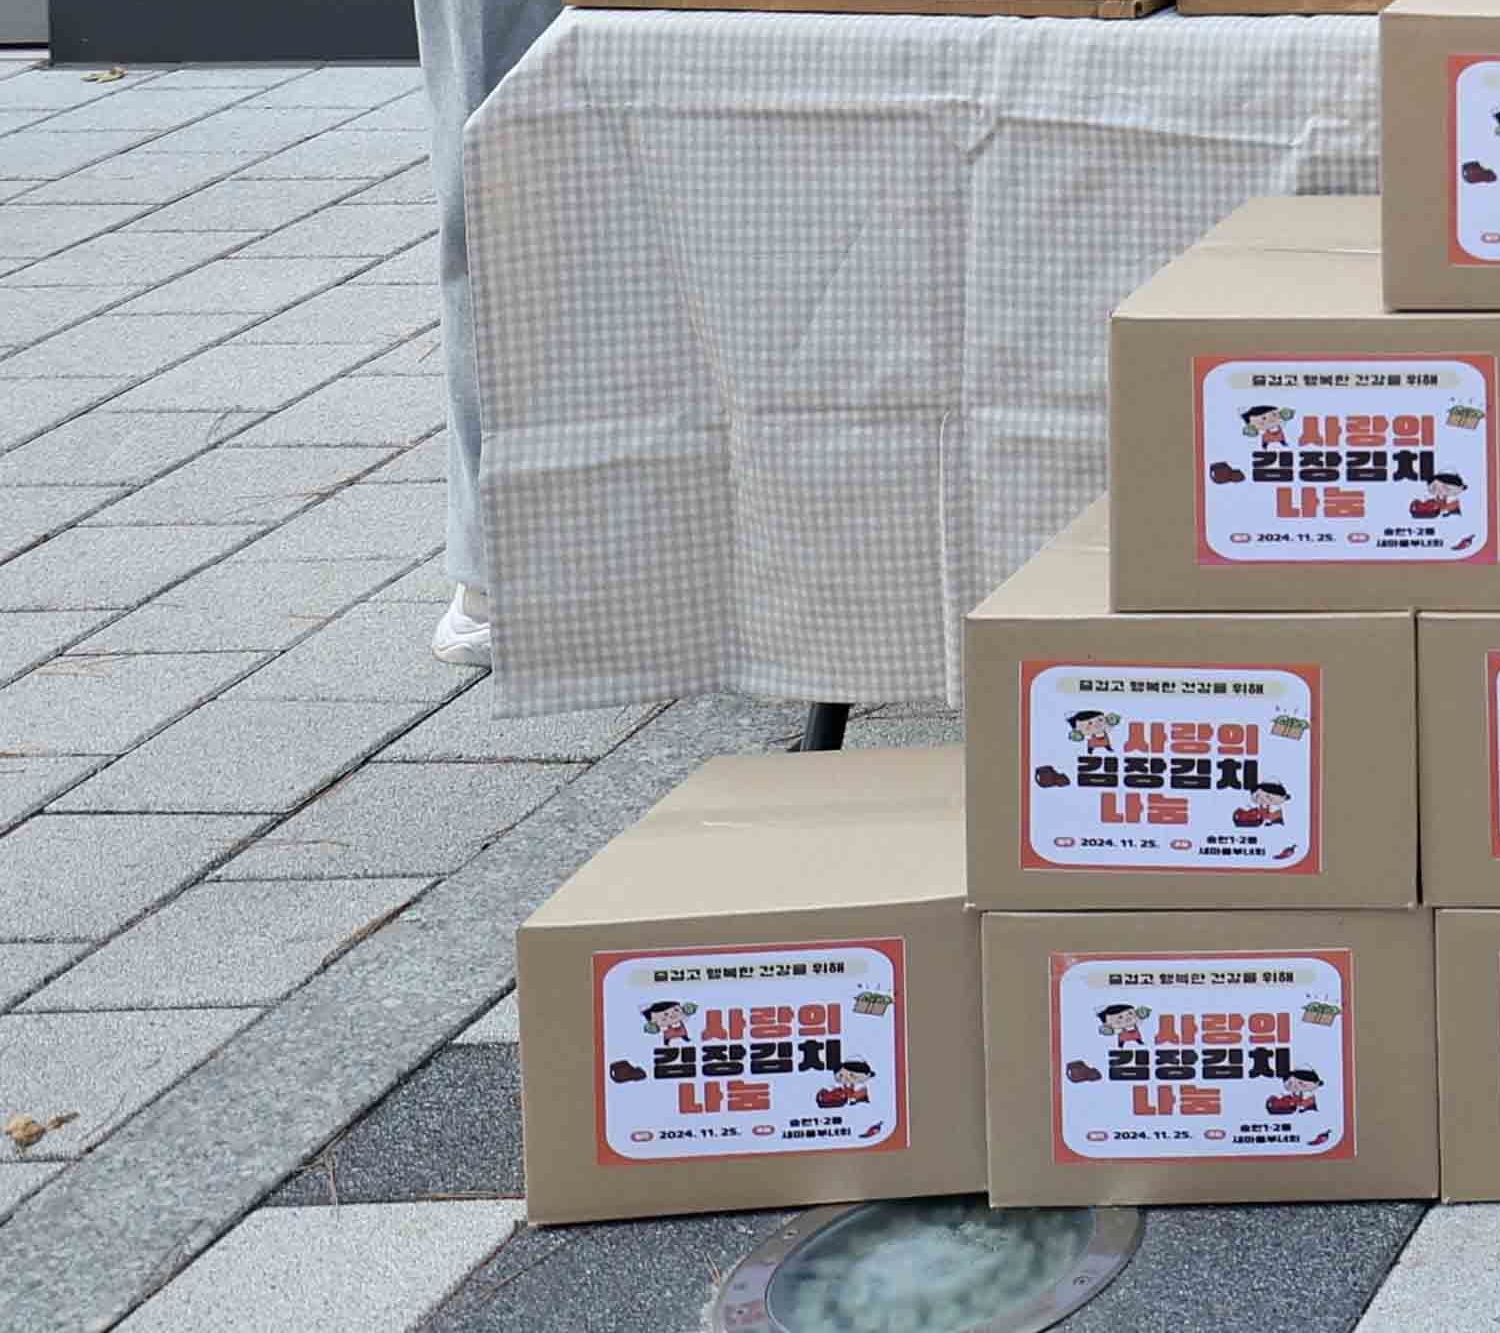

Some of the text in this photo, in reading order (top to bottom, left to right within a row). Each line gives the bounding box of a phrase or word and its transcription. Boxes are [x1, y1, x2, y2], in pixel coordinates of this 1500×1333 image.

[1124, 722, 1259, 755] 사랑의
[1077, 755, 1258, 790] 김장김치
[1100, 792, 1189, 824] 나눔
